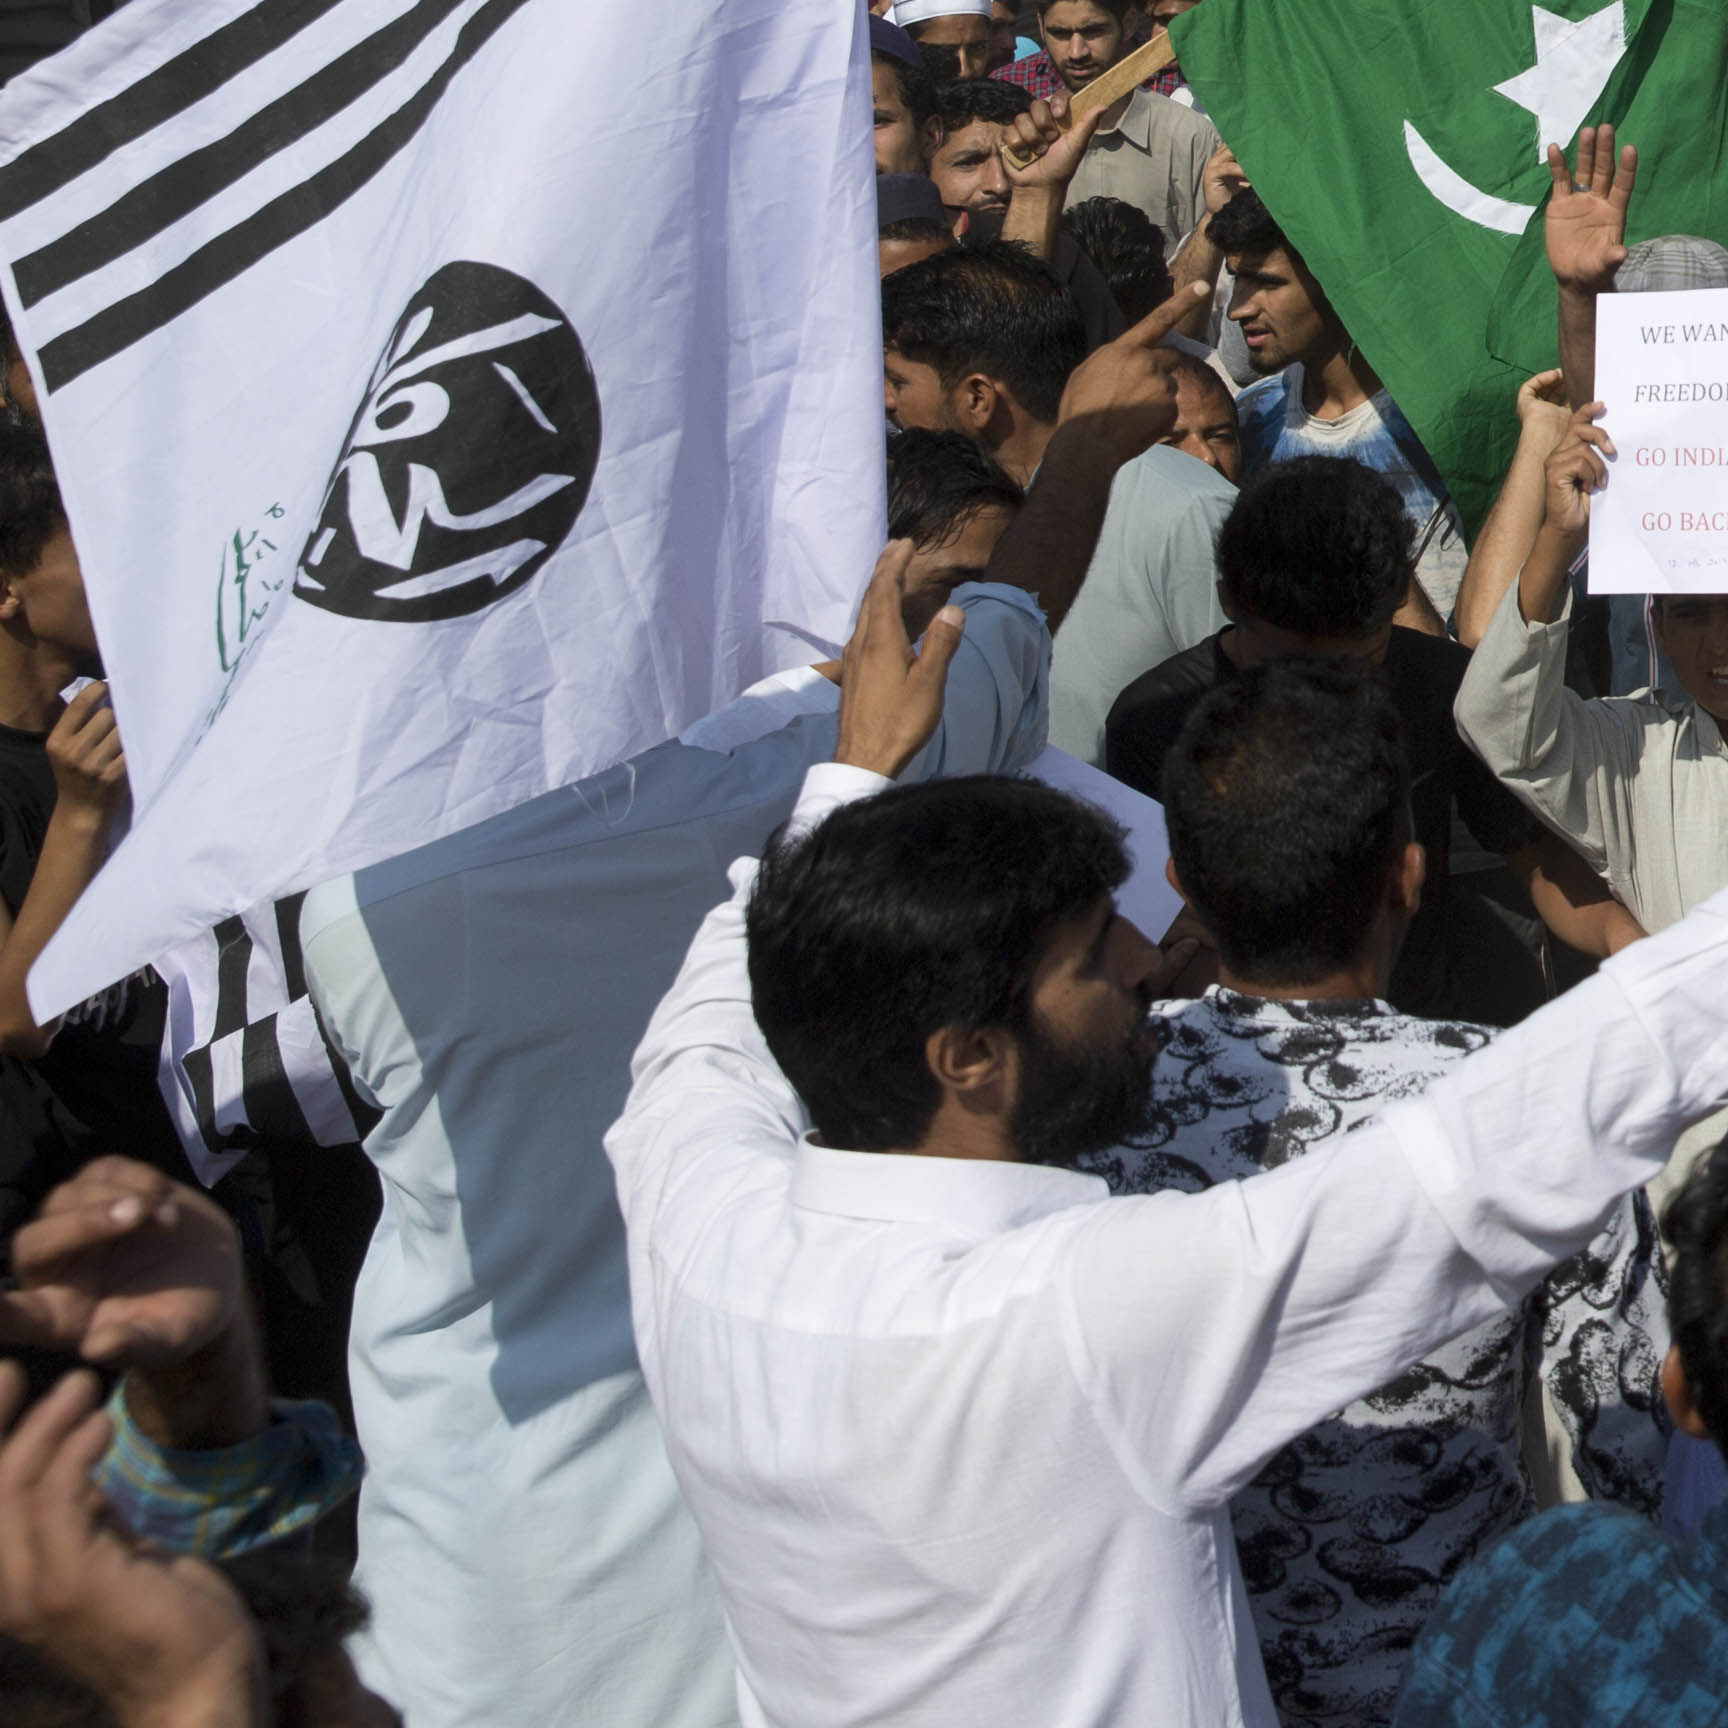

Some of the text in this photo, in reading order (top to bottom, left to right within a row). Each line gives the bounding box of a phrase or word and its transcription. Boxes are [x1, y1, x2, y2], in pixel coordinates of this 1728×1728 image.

[1641, 326, 1675, 344] WE
[1636, 447, 1667, 467] GO
[1642, 512, 1672, 531] GO
